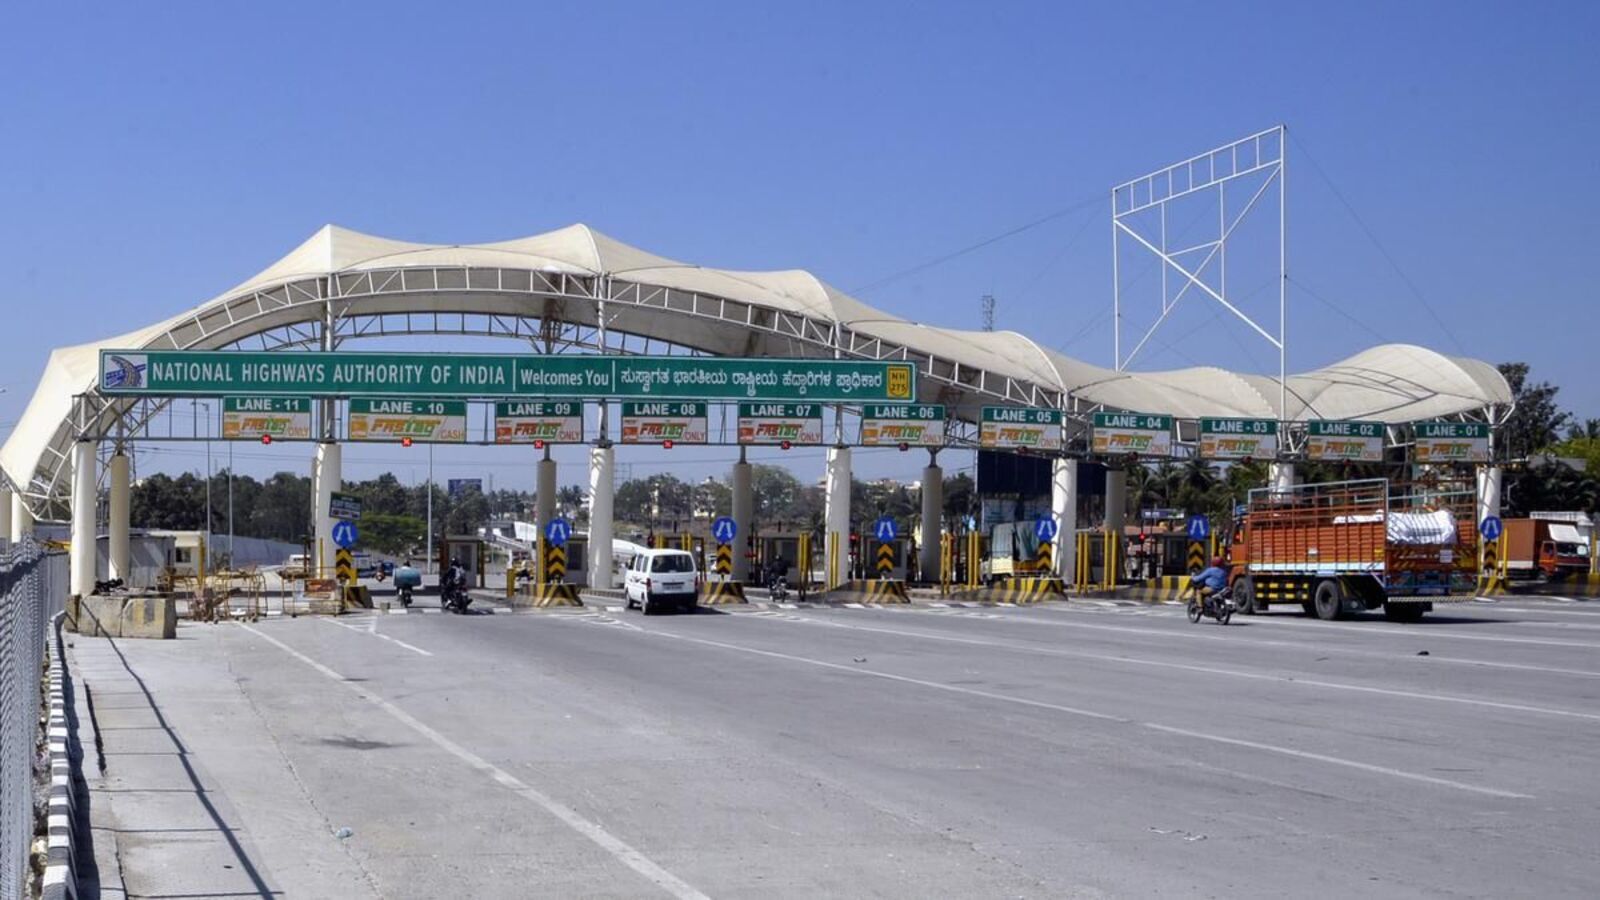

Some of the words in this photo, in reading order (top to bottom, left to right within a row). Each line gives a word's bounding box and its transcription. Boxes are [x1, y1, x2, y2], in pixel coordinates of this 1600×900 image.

[152, 362, 233, 381] NATIONAL
[242, 363, 325, 383] HIGHWAYS
[333, 364, 423, 384] AUTHORITY
[431, 365, 451, 384] OF
[459, 366, 505, 385] INDIA
[521, 368, 583, 386] Welcomes
[585, 369, 609, 387] You
[891, 372, 905, 380] NH
[891, 384, 906, 392] 275
[236, 398, 272, 410] LANE
[284, 399, 299, 411] 11
[370, 401, 413, 413] LANE
[428, 403, 444, 414] 10
[508, 403, 543, 415] LANE
[554, 403, 571, 415] 09
[634, 403, 669, 415] LANE
[681, 404, 696, 415] 08
[751, 405, 785, 416] LANE
[796, 405, 811, 416] 07
[874, 407, 908, 417] LANE
[920, 407, 934, 418] 06
[993, 410, 1026, 421] LANE
[1037, 411, 1052, 422] 05
[1104, 416, 1137, 427] LANE
[1147, 417, 1162, 428] 04
[1211, 421, 1243, 432] LANE
[1253, 422, 1267, 432] 03
[1320, 423, 1351, 434] LANE
[1360, 425, 1374, 435] 02
[1426, 426, 1457, 436] LANE
[1466, 426, 1479, 436] 01
[684, 431, 705, 441] ONLY
[801, 432, 820, 442] ONLY
